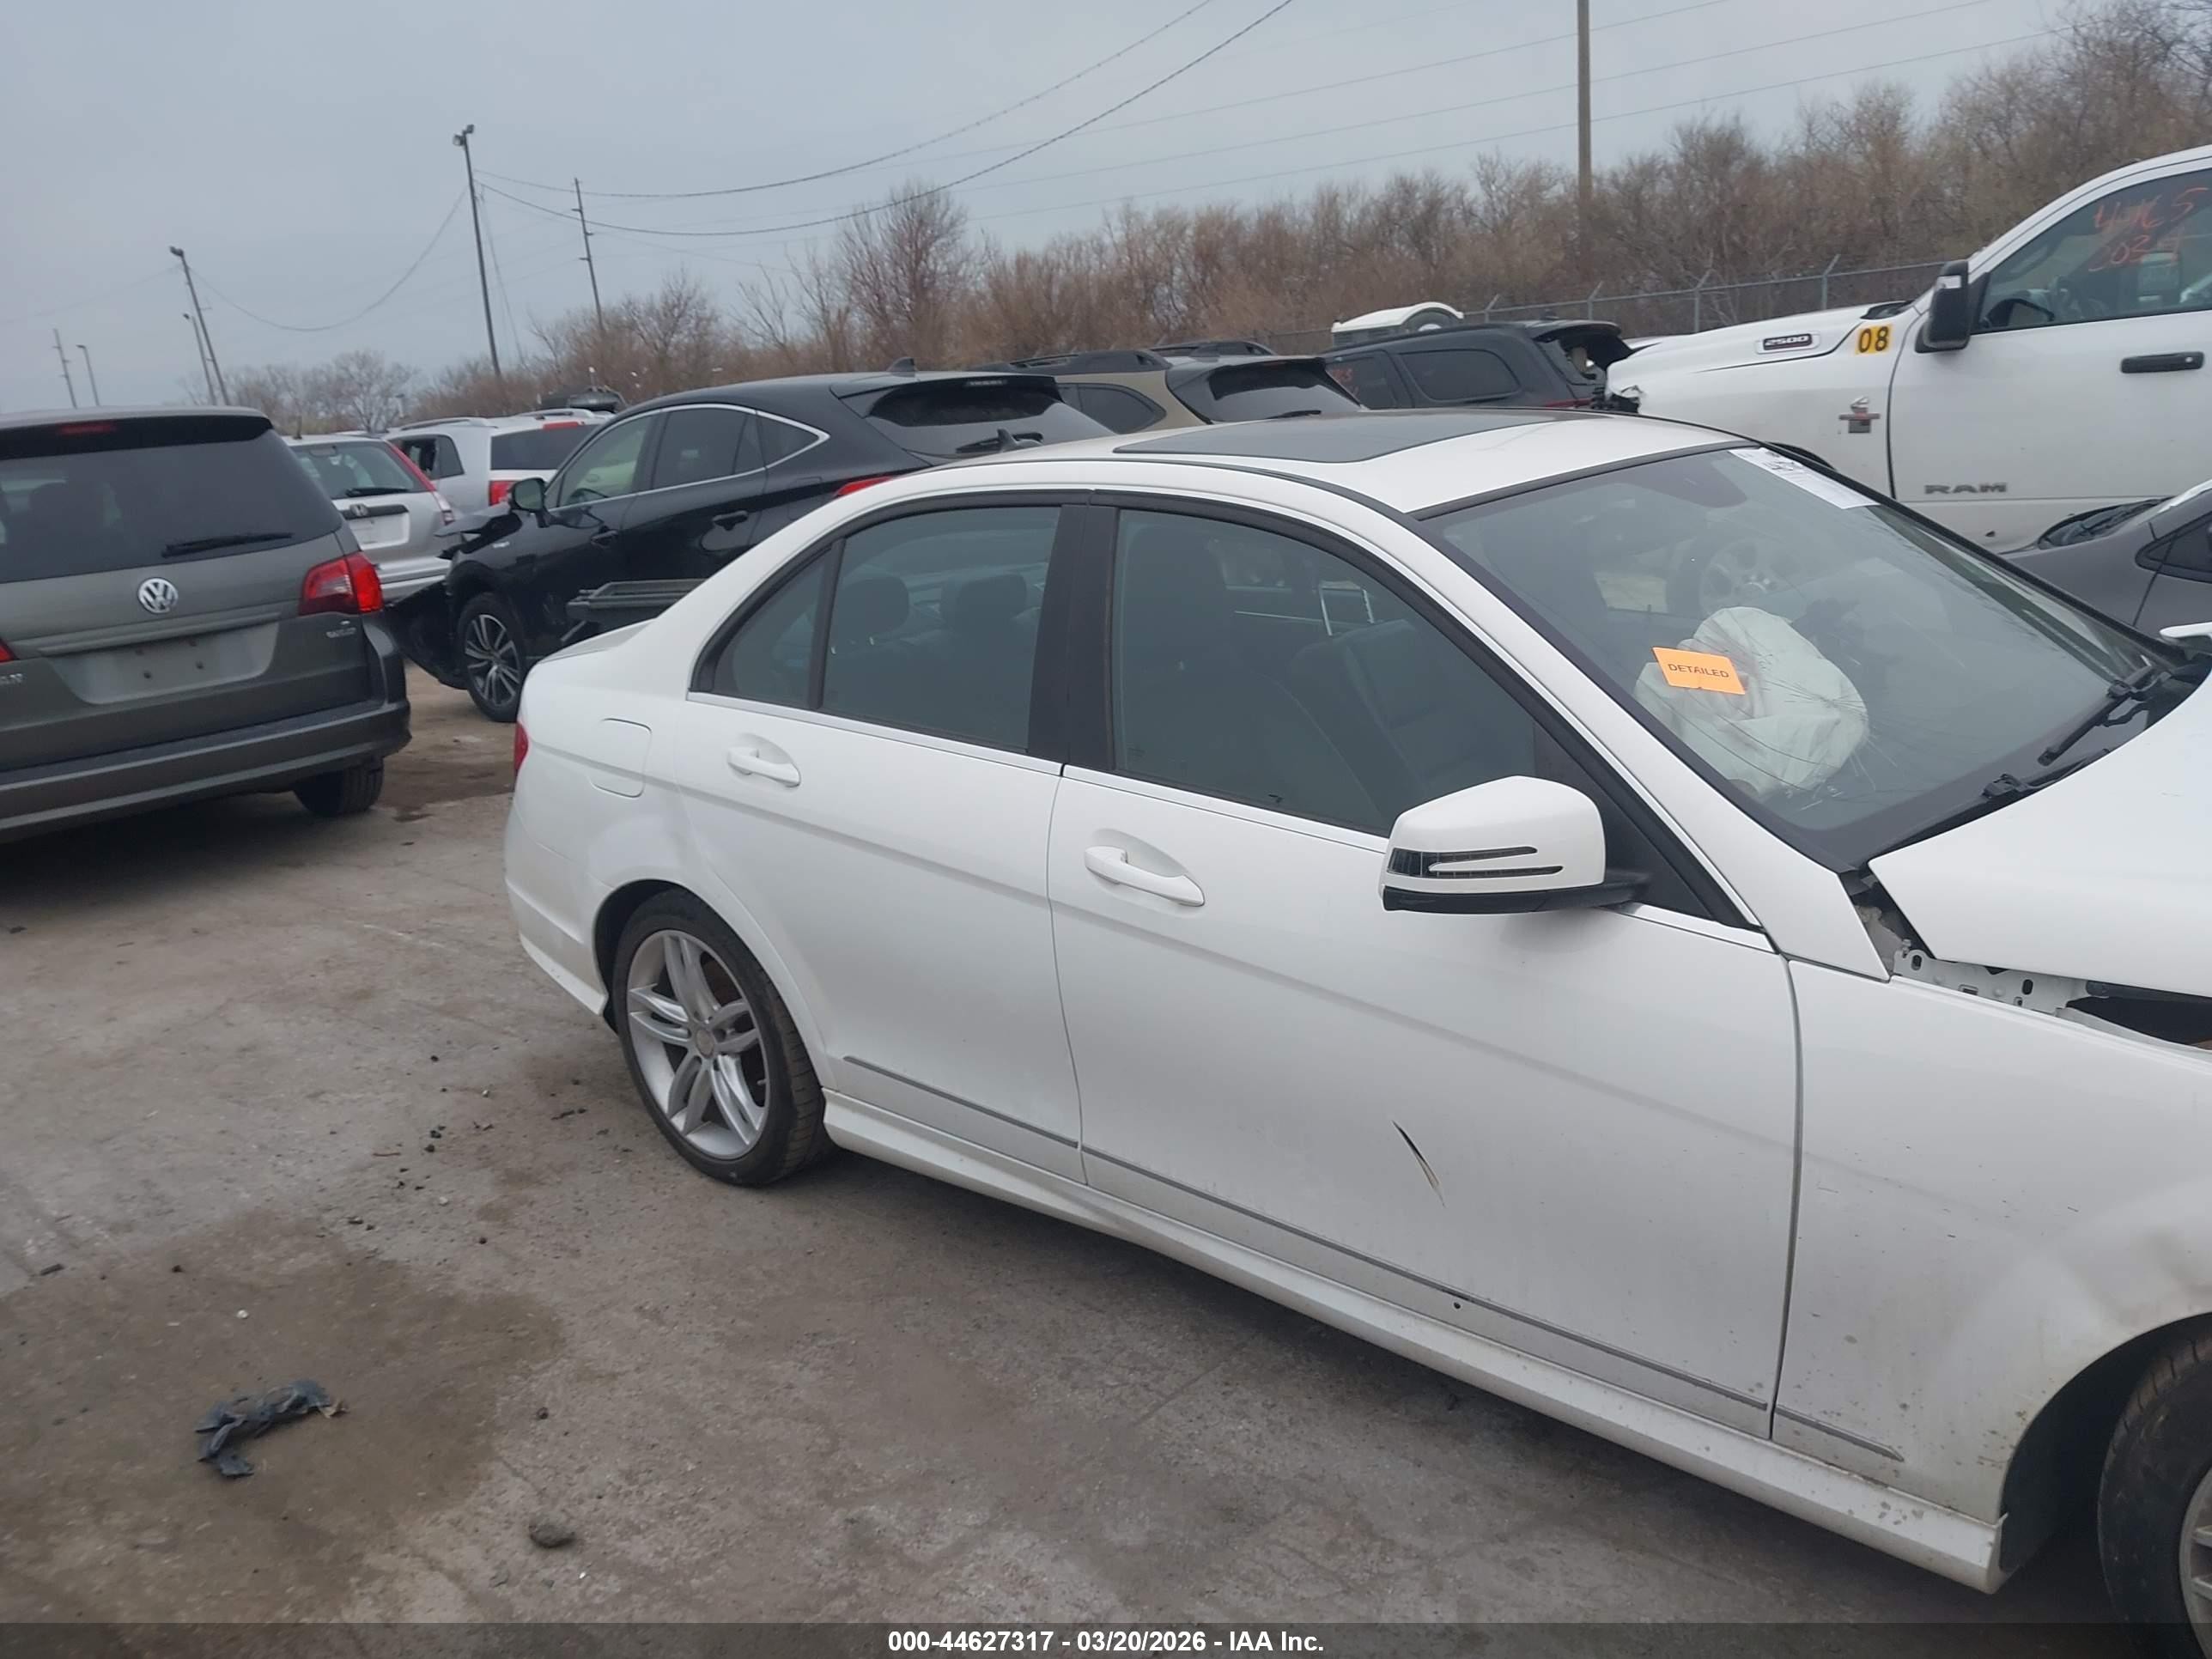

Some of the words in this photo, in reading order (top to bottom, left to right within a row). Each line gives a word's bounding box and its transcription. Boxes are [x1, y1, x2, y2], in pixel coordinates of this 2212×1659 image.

[1765, 335, 1809, 347] 2500
[1858, 325, 1889, 354] 08
[1924, 483, 2008, 495] RAM
[1667, 662, 1730, 679] DETAILED
